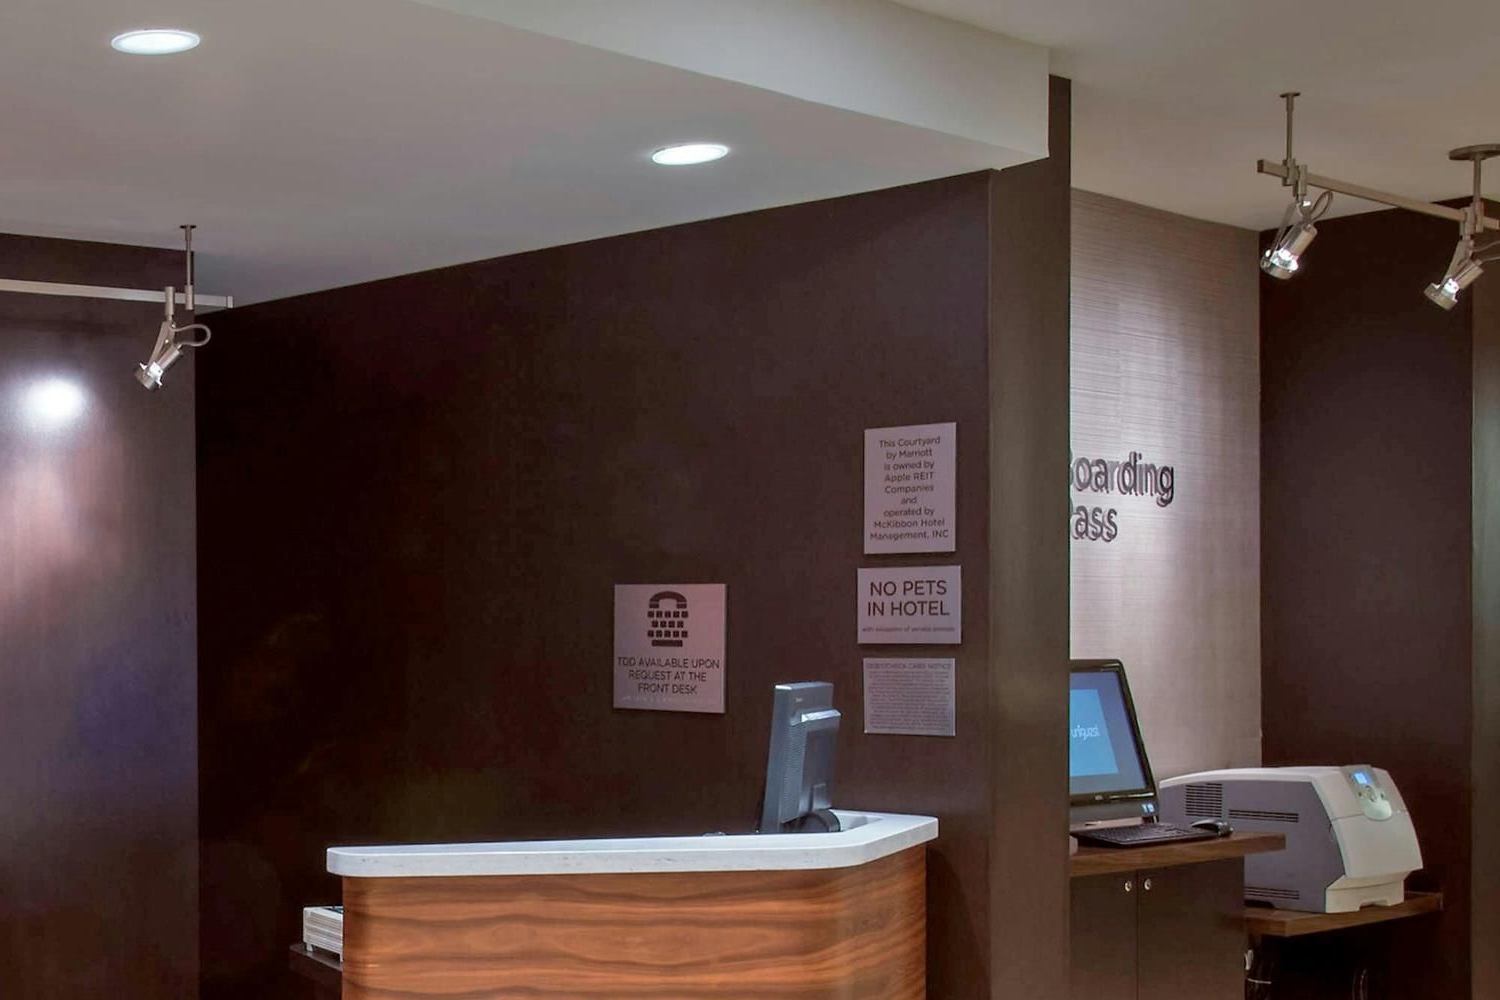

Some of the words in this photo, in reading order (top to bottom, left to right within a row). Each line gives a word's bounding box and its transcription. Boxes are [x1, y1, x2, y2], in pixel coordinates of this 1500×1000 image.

[879, 440, 896, 448] This
[898, 436, 941, 447] Courtyard
[886, 451, 896, 460] by
[899, 449, 933, 459] Marriott
[892, 460, 922, 470] owned
[924, 460, 934, 470] by
[884, 474, 911, 483] Apple
[913, 471, 934, 481] REIT
[1070, 451, 1174, 507] oarding
[884, 483, 934, 494] Companies
[900, 496, 917, 504] and
[883, 507, 922, 518] operated
[924, 506, 935, 516] by
[920, 518, 945, 527] Hotel
[1070, 505, 1118, 543] ass
[870, 580, 897, 597] NO
[902, 580, 948, 596] PETS
[867, 601, 885, 617] IN
[890, 600, 951, 617] HOTEL
[639, 657, 689, 668] AVAILABLE
[691, 659, 720, 669] UPON
[628, 670, 672, 680] REQUEST
[674, 671, 687, 681] AT
[689, 672, 707, 682] THE
[637, 683, 669, 694] FRONT
[671, 684, 698, 694] DESK
